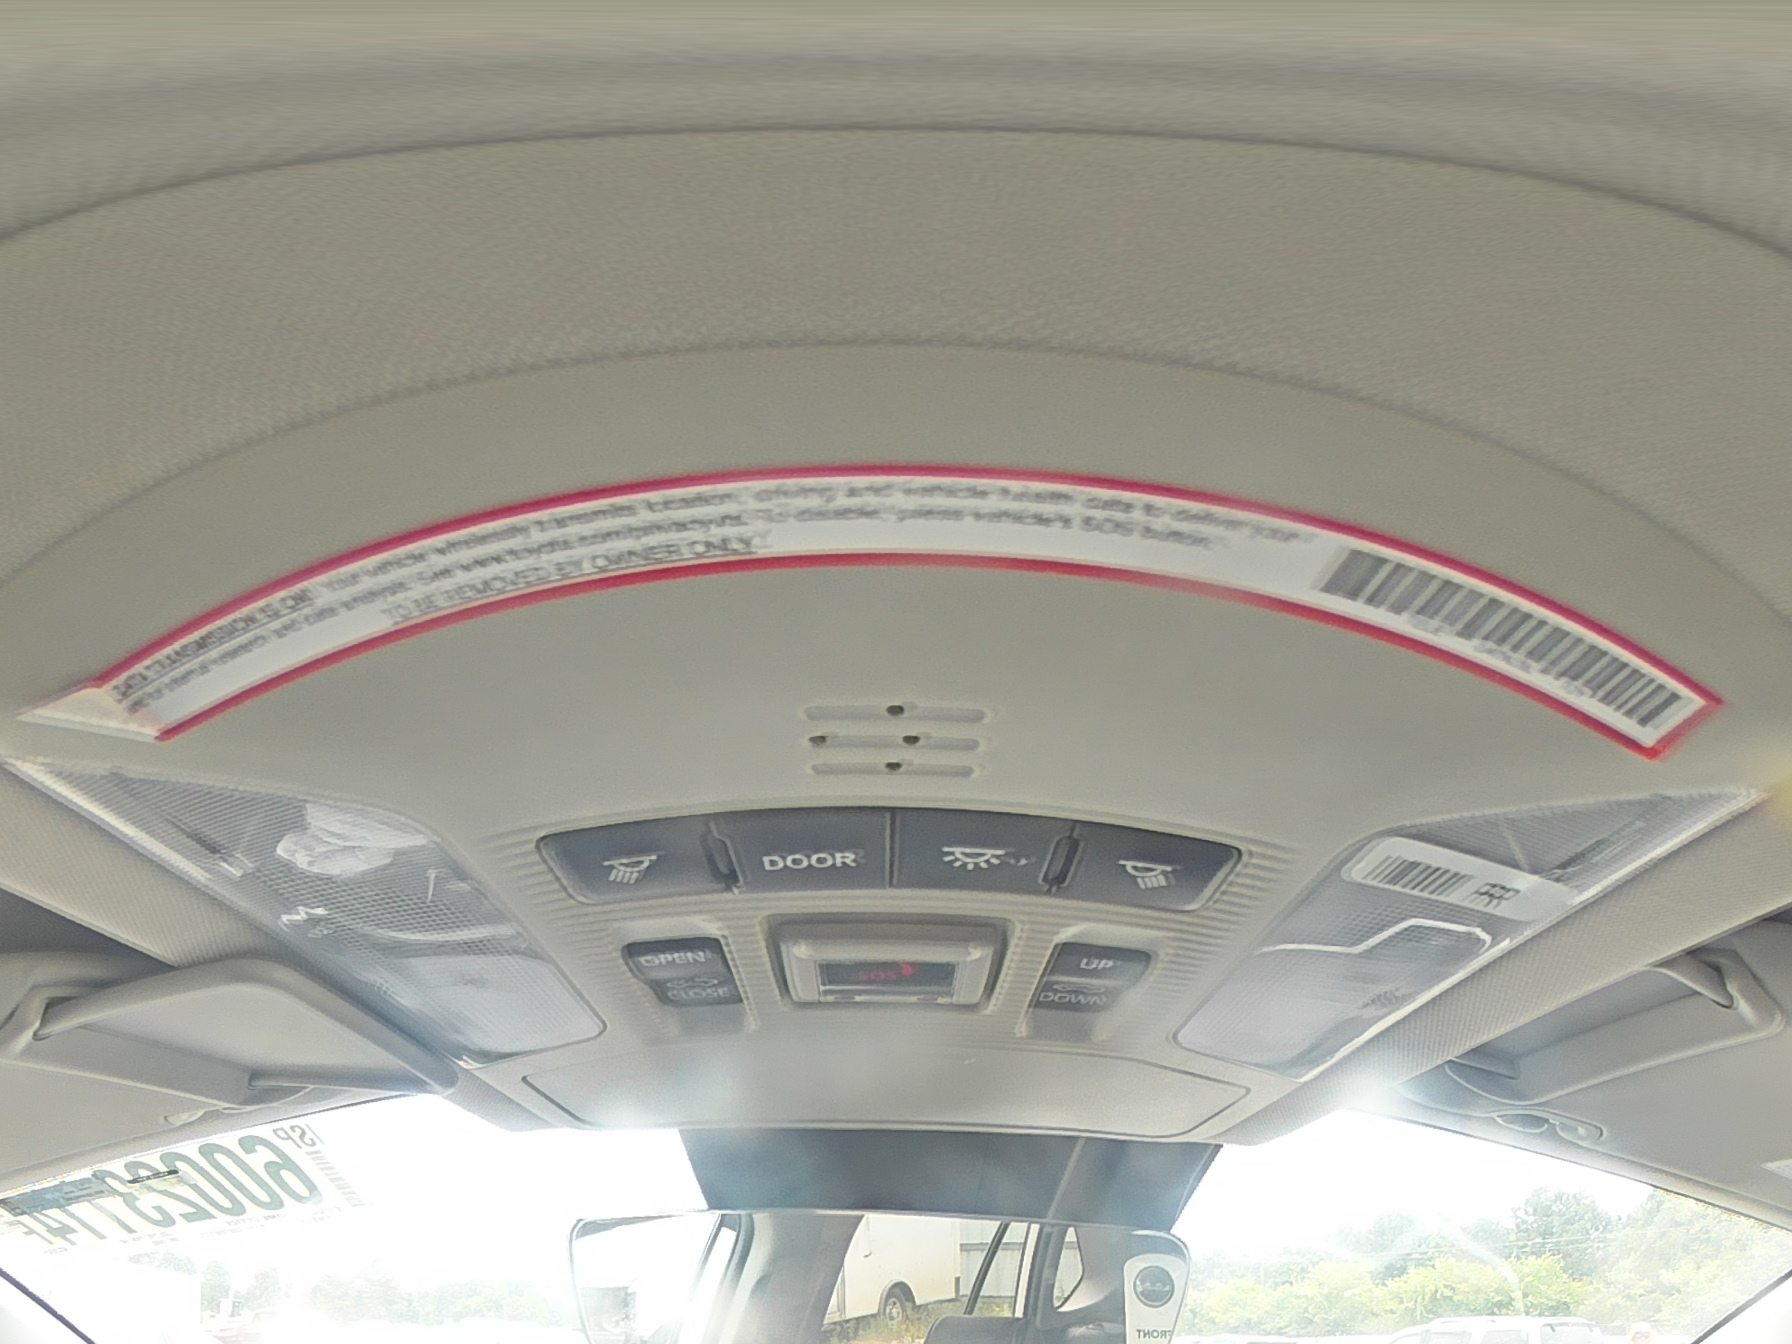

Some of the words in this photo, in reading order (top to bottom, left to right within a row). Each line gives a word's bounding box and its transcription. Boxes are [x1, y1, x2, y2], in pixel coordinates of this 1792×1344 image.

[762, 852, 858, 871] DOOR
[639, 951, 706, 967] OPEN
[1080, 958, 1114, 970] UP
[859, 972, 896, 981] SOS
[667, 988, 728, 1000] CLOSE
[1039, 992, 1107, 1005] DOWN
